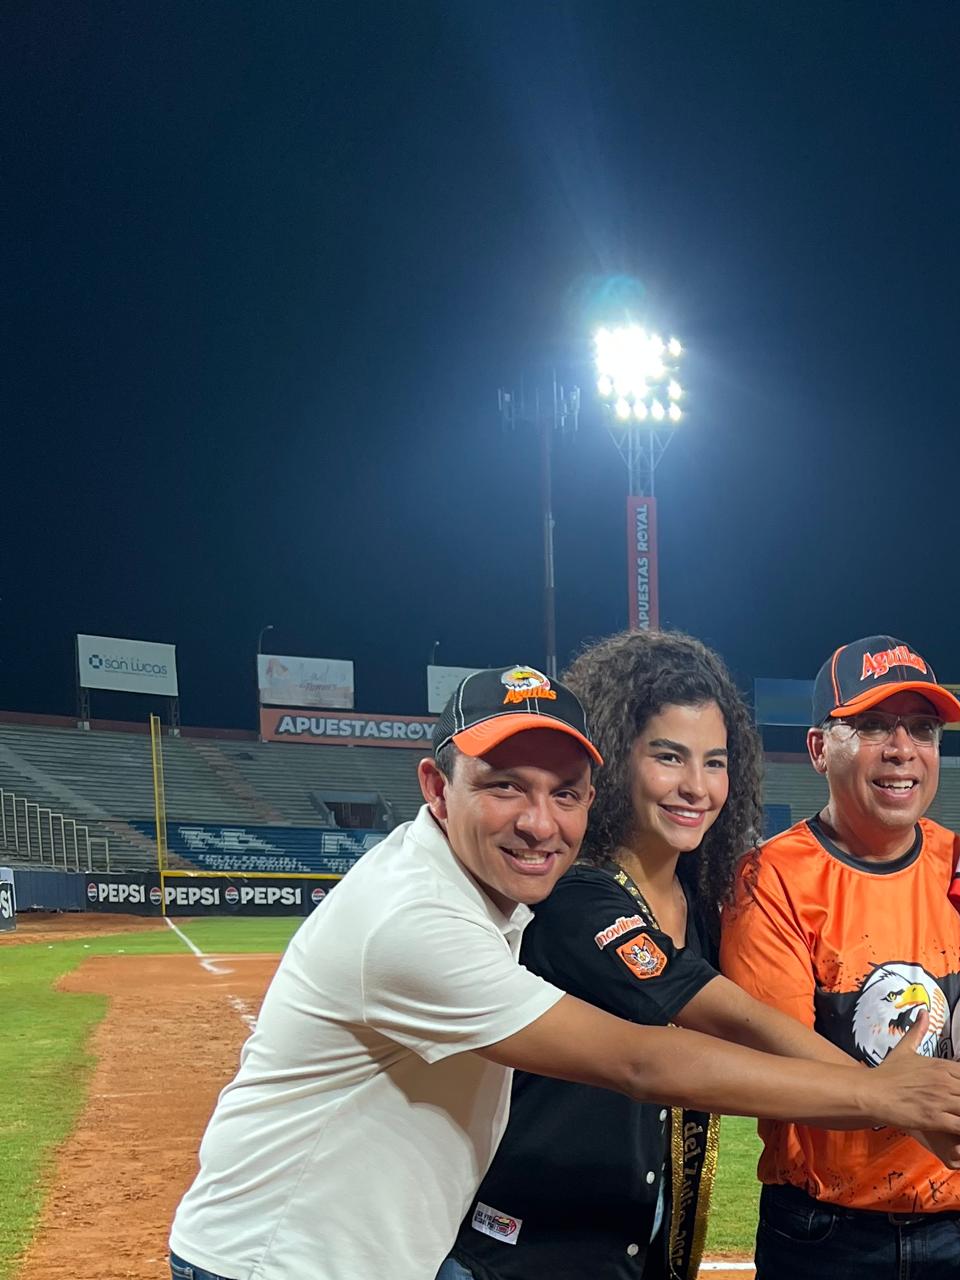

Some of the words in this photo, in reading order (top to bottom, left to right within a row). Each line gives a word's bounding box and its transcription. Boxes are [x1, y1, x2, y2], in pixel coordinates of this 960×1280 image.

[636, 504, 649, 552] ROYAL
[637, 557, 650, 631] APUESTAS
[278, 716, 436, 739] APUESTASROY
[98, 883, 146, 903] PEPSI
[164, 887, 220, 905] PEPSI
[241, 887, 302, 905] PEPSI
